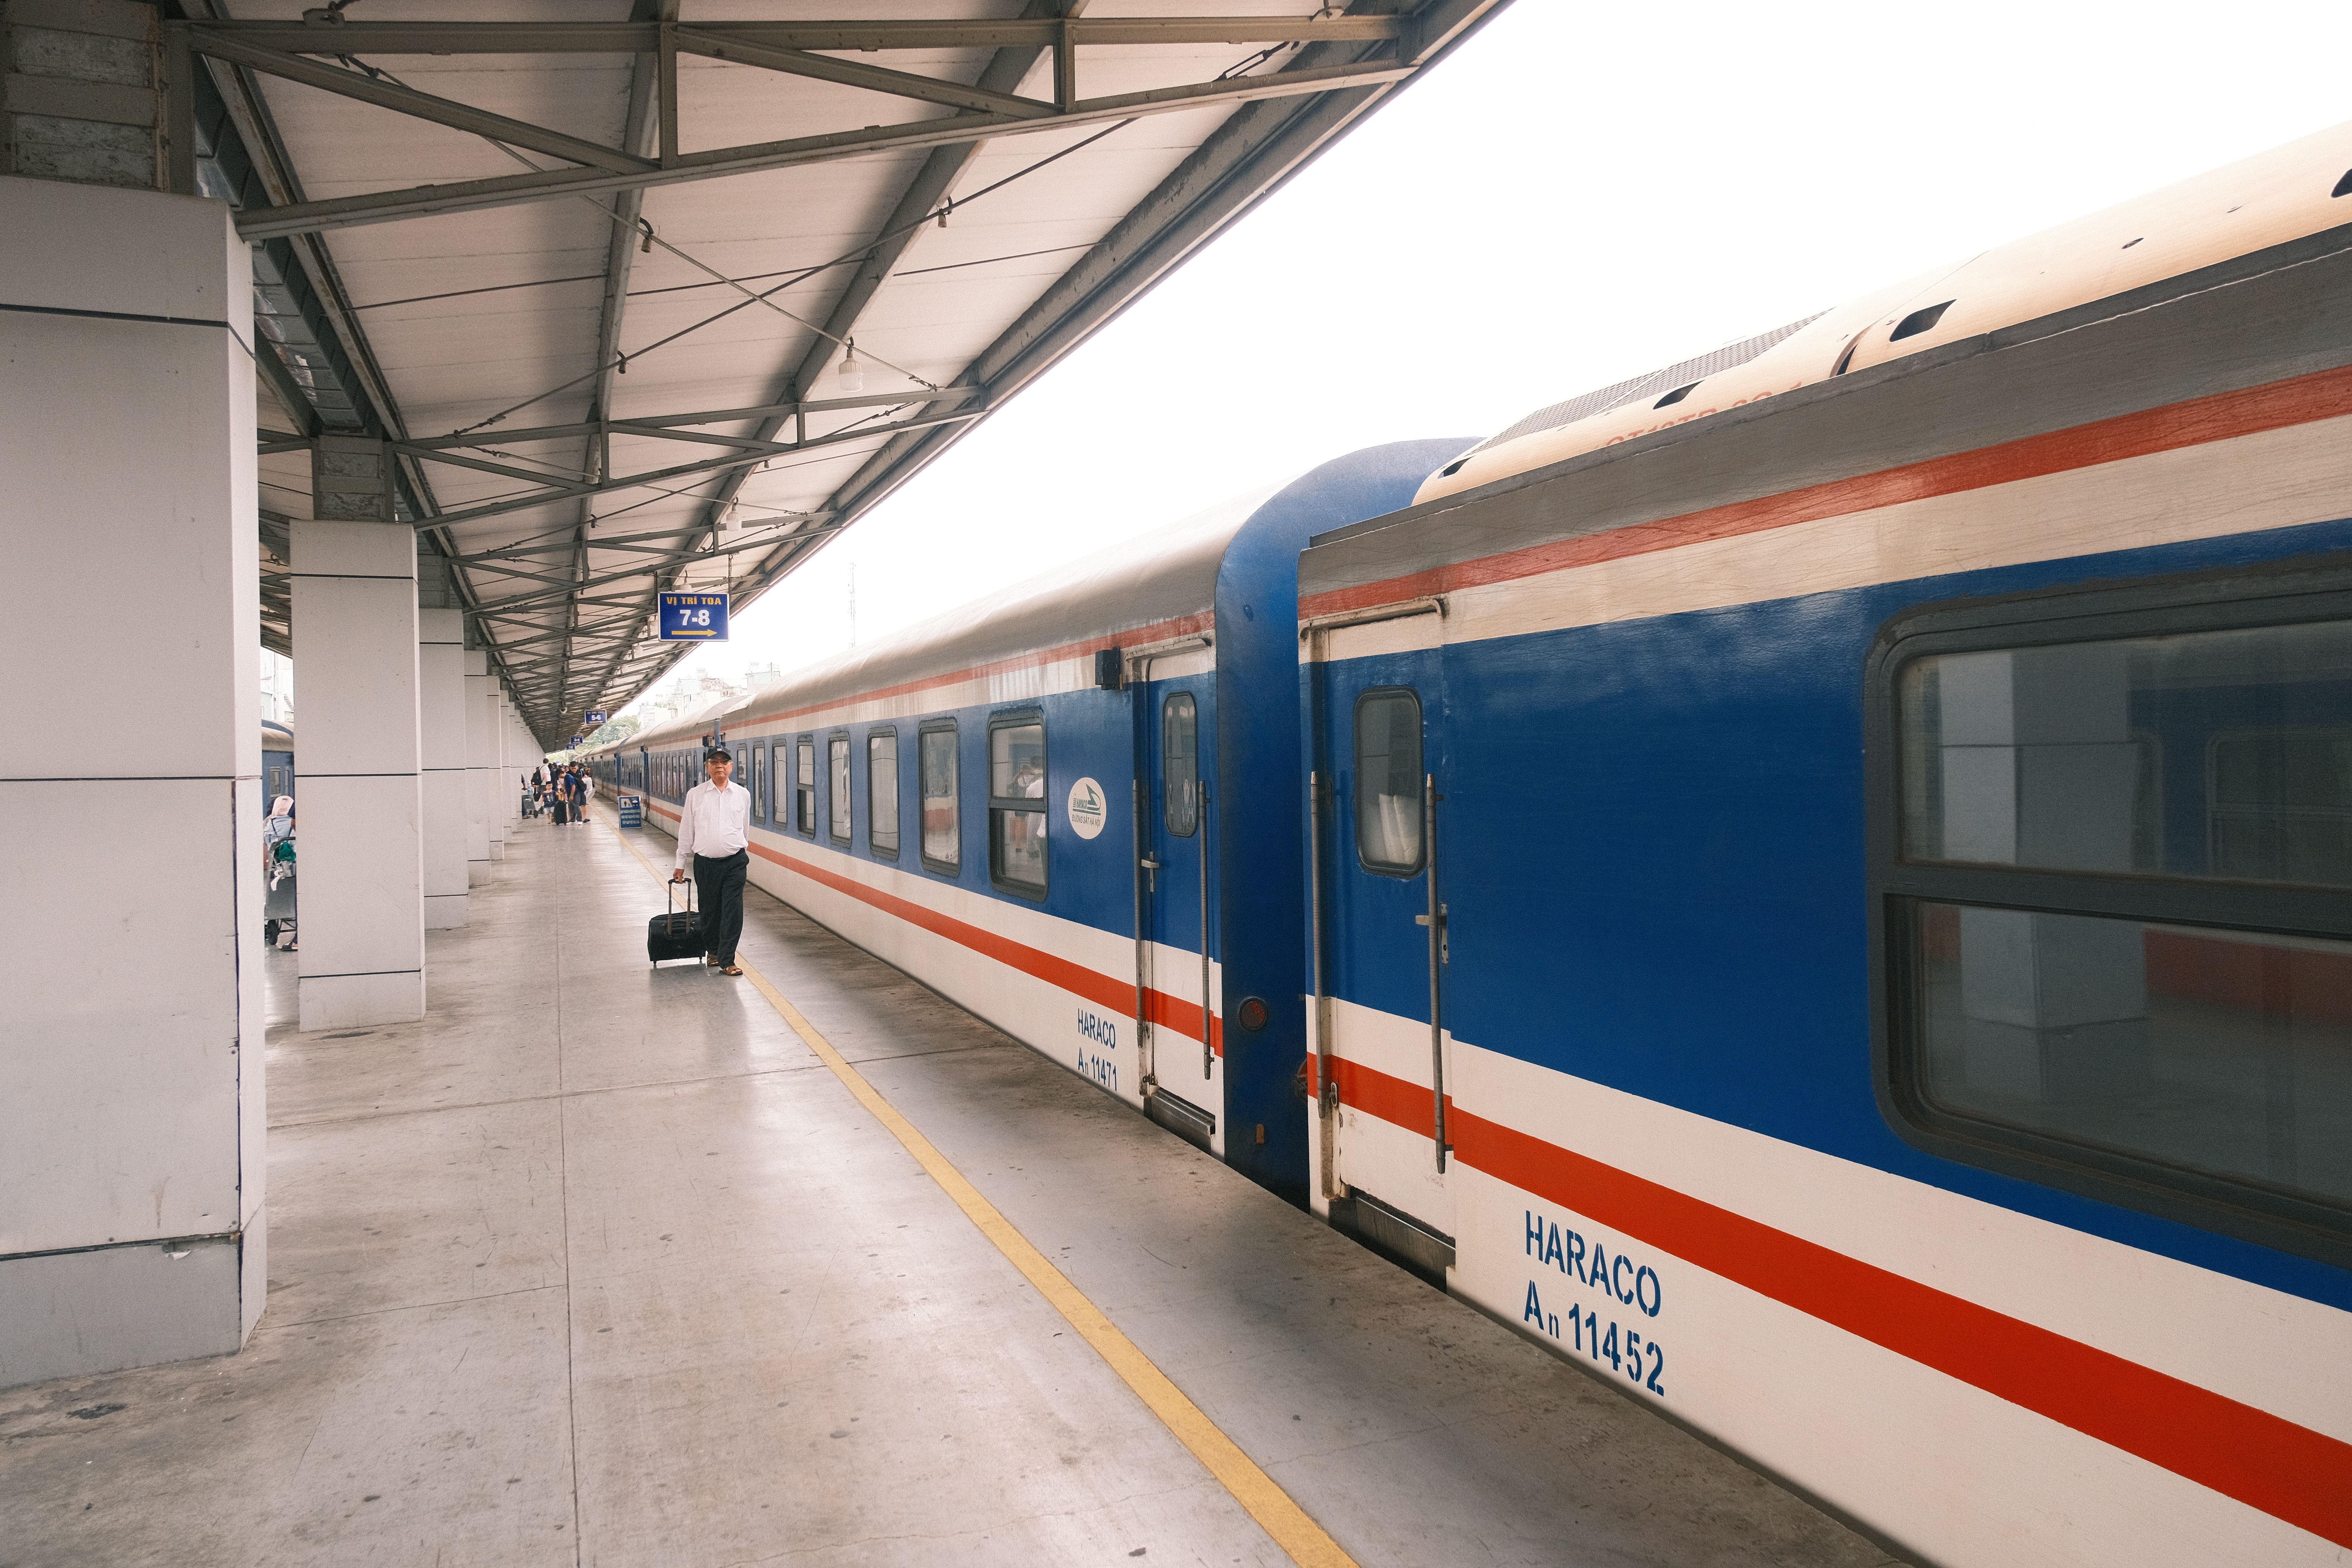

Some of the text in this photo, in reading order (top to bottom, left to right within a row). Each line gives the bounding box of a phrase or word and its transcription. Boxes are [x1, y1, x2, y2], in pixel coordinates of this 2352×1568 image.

[666, 597, 677, 605] VỊ
[681, 596, 697, 605] TRÍ
[680, 609, 710, 626] 7-8
[1072, 813, 1083, 823] ĐƯỜNG
[1076, 798, 1087, 810] HARACO
[1078, 1008, 1116, 1049] HARACO
[1078, 1047, 1117, 1091] An 11471
[1526, 1210, 1661, 1317] HARACO
[1524, 1280, 1664, 1397] An 11452
